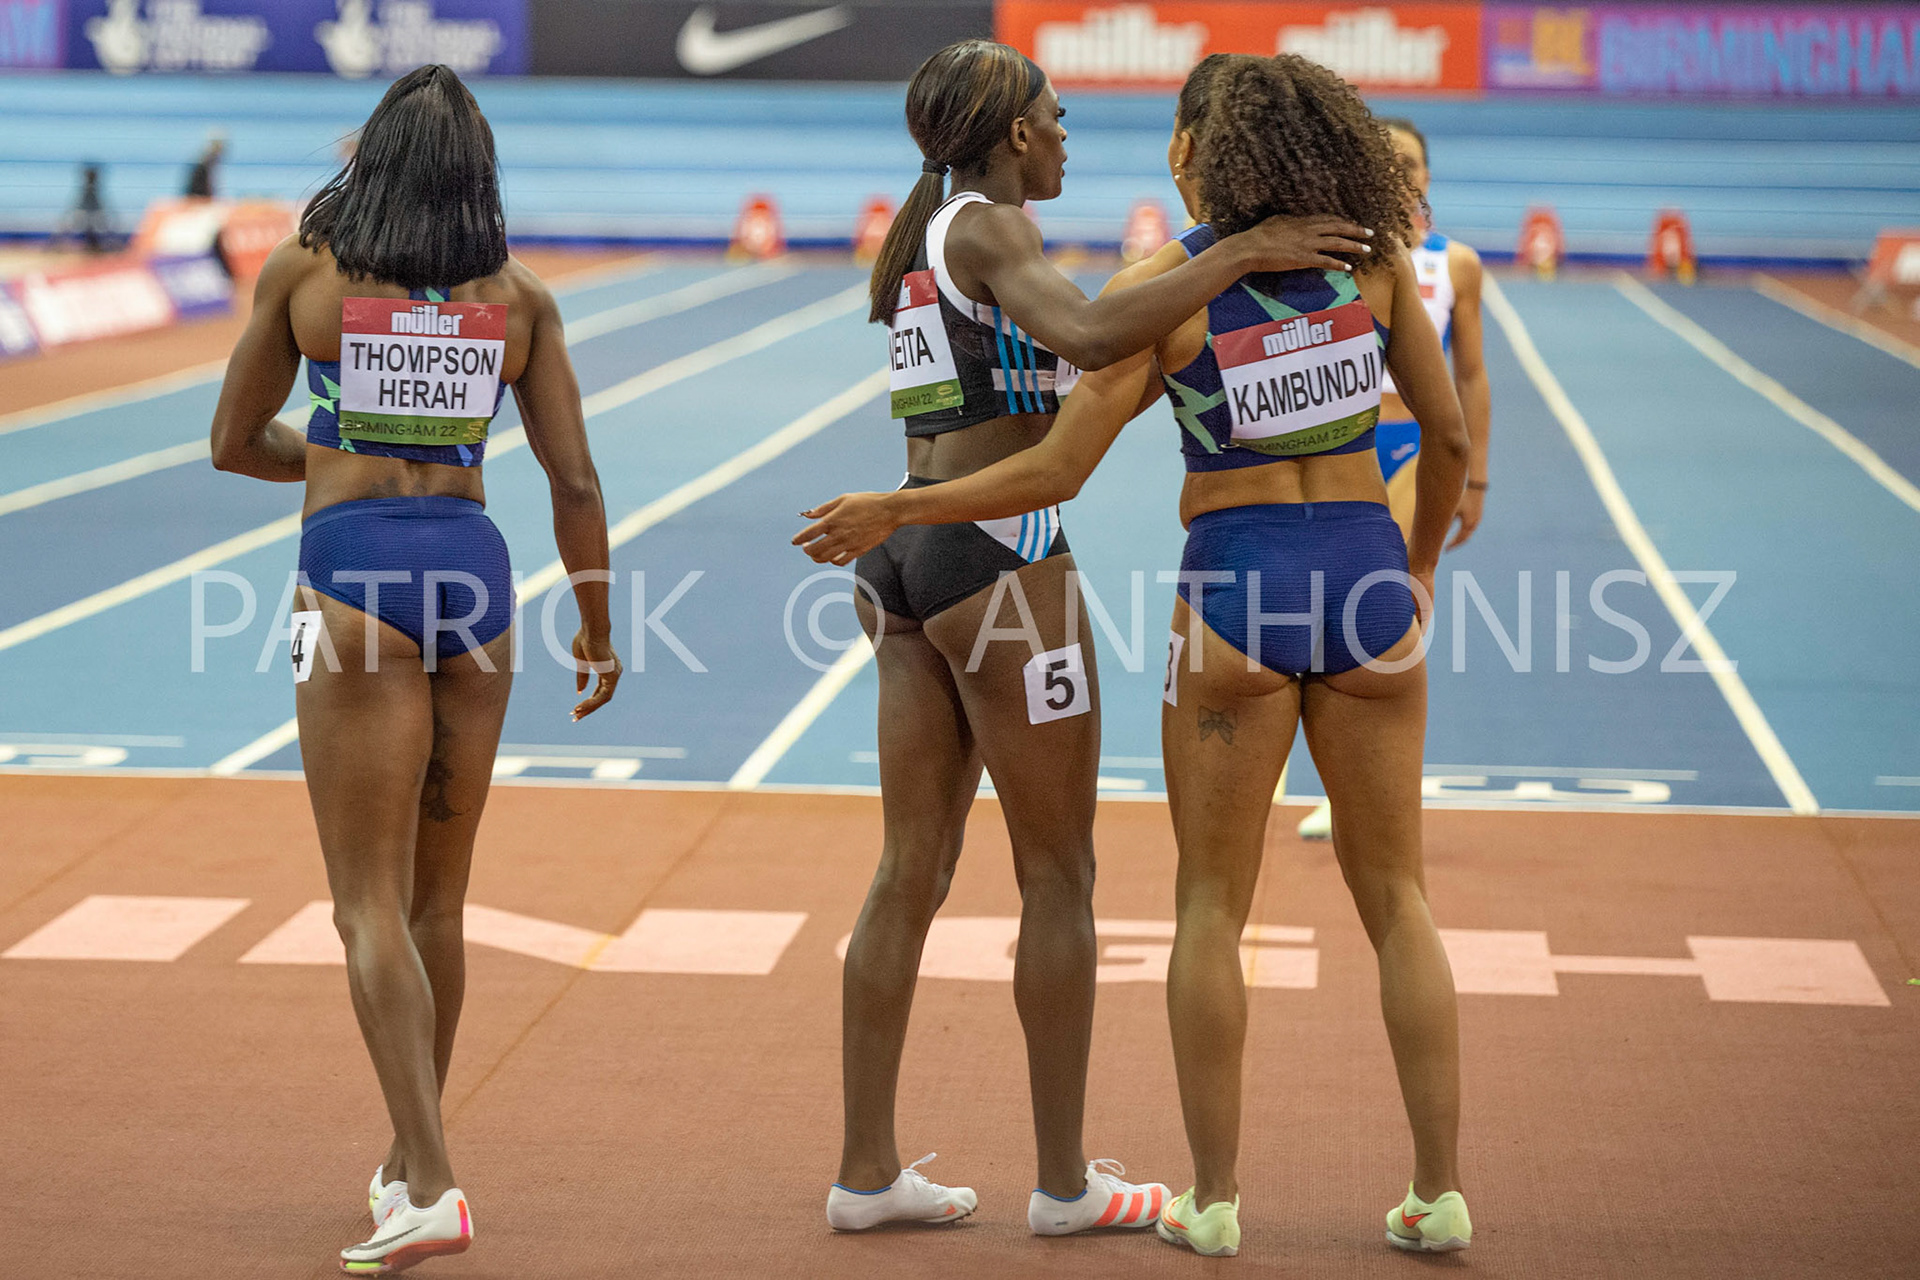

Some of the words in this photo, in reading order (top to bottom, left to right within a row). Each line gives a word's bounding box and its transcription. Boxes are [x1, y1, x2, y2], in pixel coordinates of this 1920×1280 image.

[391, 305, 463, 336] müller
[1262, 317, 1333, 357] müller
[350, 342, 496, 376] THOMPSON
[379, 378, 467, 410] HERAH
[1232, 352, 1377, 425] KAMBUNDJI
[344, 419, 436, 437] BIRMINGHAM
[440, 425, 457, 437] 22
[1332, 426, 1348, 440] 22
[291, 622, 306, 673] 4
[1045, 658, 1075, 711] 5
